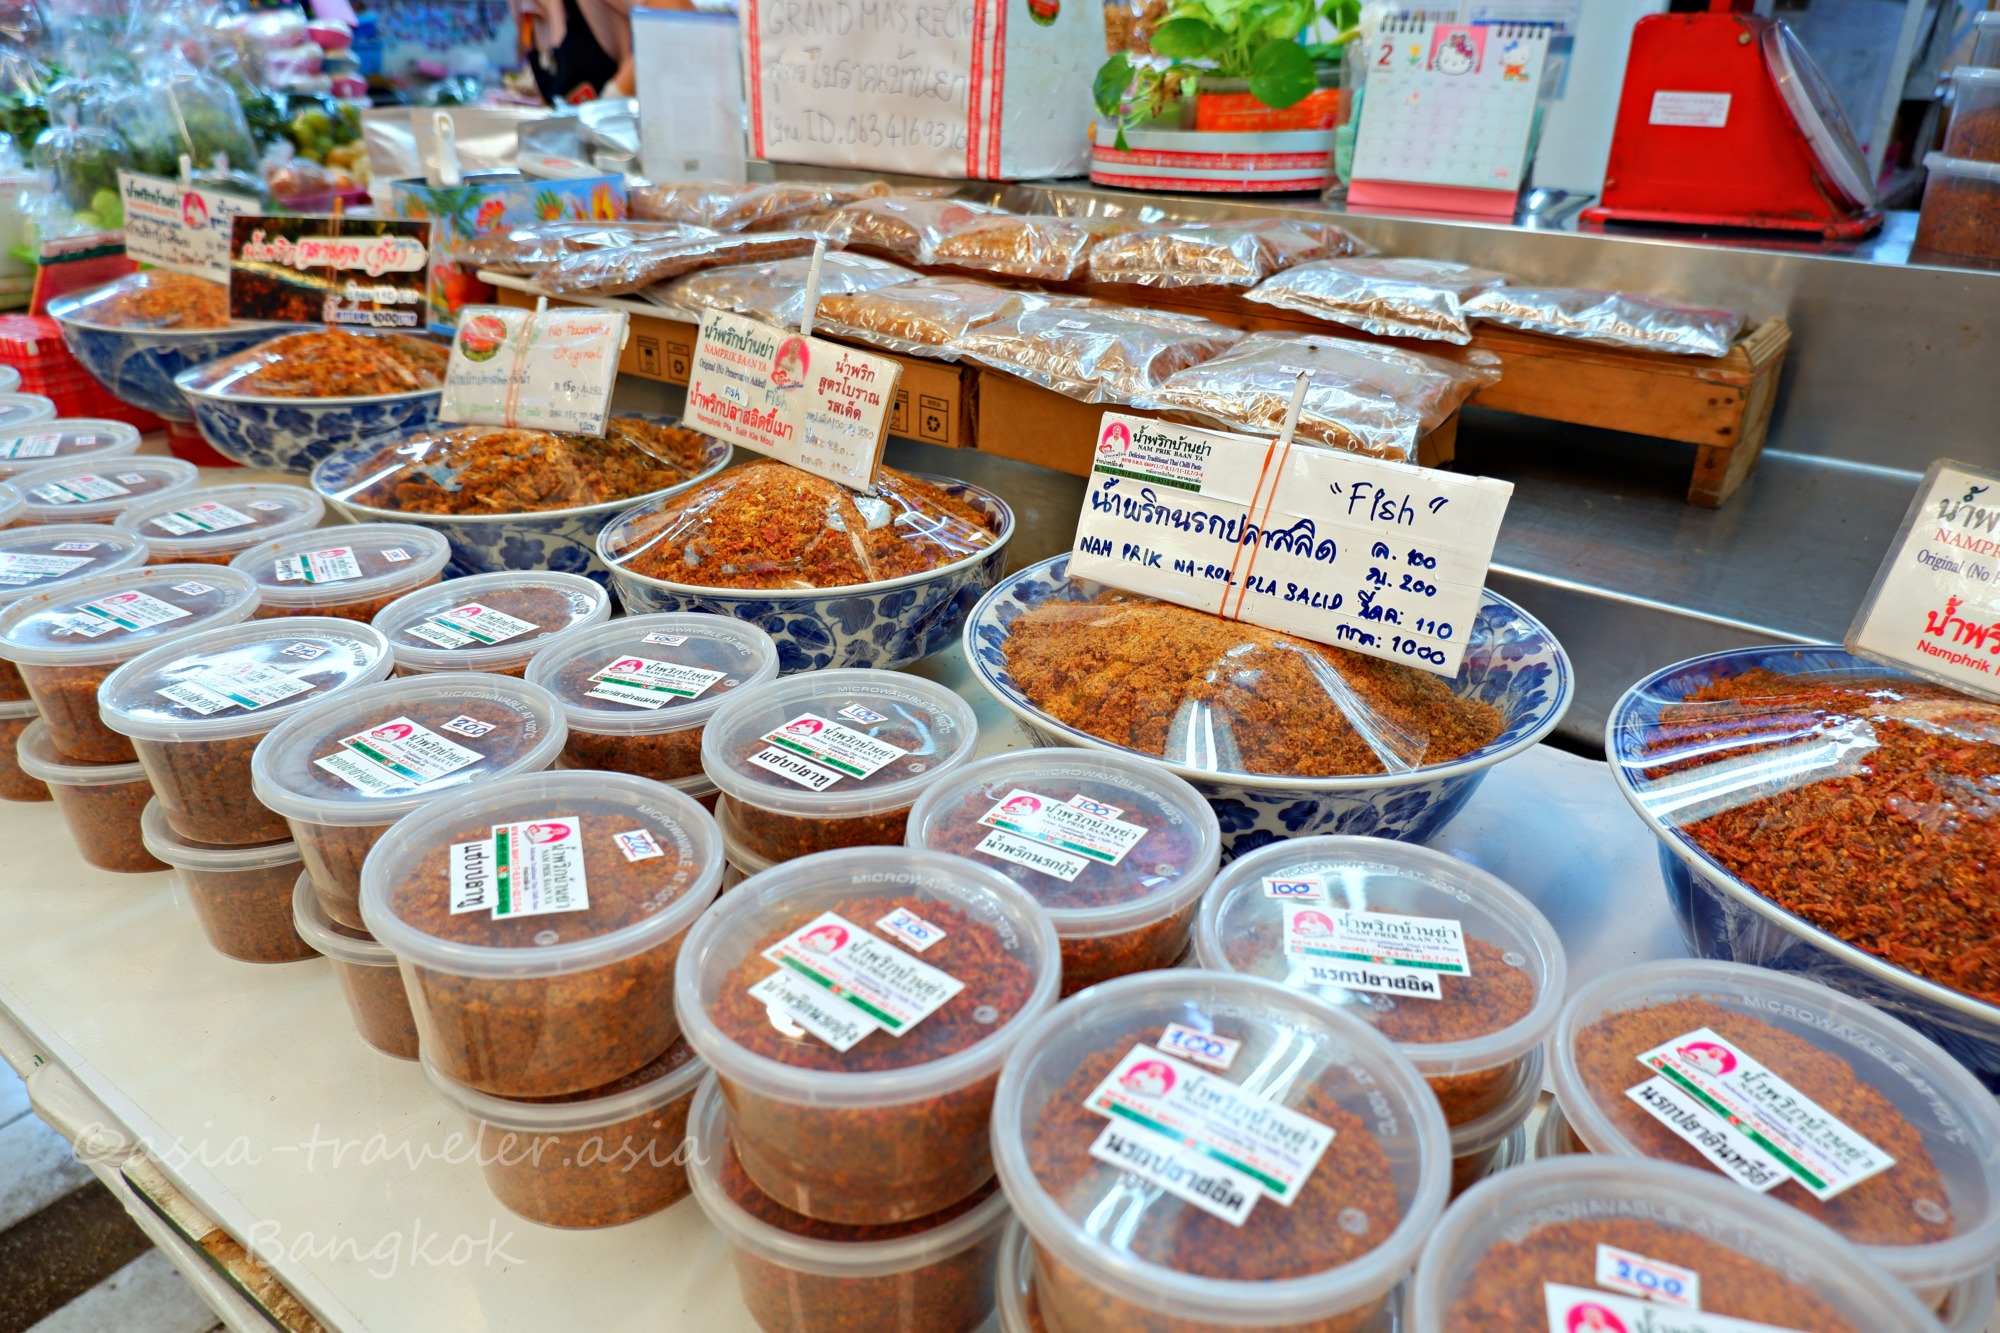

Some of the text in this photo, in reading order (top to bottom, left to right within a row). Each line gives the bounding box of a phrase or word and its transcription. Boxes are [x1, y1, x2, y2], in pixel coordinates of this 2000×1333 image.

[705, 316, 775, 360] น้ำพริกบ้านย่า
[703, 344, 767, 372] NAMPRIK BAAN YA
[835, 353, 875, 383] น้ำพริก
[818, 377, 881, 407] สูตรโบราณ
[690, 381, 793, 441] น้ำพริกปลาสลิดขี้เมา
[827, 399, 862, 421] รสเด็ด
[1133, 425, 1212, 457] น้ำพริกบ้านย่า
[1138, 445, 1153, 454] NAM
[1174, 452, 1192, 461] BAAN
[1091, 477, 1337, 565] น้ำพริกนรกปลาสลิด
[1407, 548, 1437, 570] 100
[1080, 535, 1113, 558] NAM
[1122, 543, 1163, 569] PRIK
[1246, 575, 1276, 597] PLA
[1917, 549, 1990, 583] Original (No
[1399, 573, 1437, 598] 200
[1415, 617, 1453, 640] 110
[1392, 635, 1446, 666] 1000
[1917, 639, 1992, 674] Namphrik
[451, 718, 486, 736] 200
[851, 707, 880, 724] 100
[823, 726, 897, 760] น้ำพริกบ้านย่า
[1034, 768, 1144, 791] MICROWAVABLE
[1045, 803, 1138, 841] น้ำพริกบ้านย่า
[1078, 801, 1110, 816] 100
[636, 804, 693, 867] MICROWAVABLE
[985, 834, 1079, 877] น้ำพริกนรกกุ้ง
[1272, 882, 1310, 895] 100
[891, 916, 930, 941] 200
[1338, 912, 1458, 940] น้ำพริกบ้านย่า
[1310, 965, 1436, 994] นรกปลาสลิด
[1168, 1029, 1225, 1058] 100
[1615, 1258, 1684, 1298] 200
